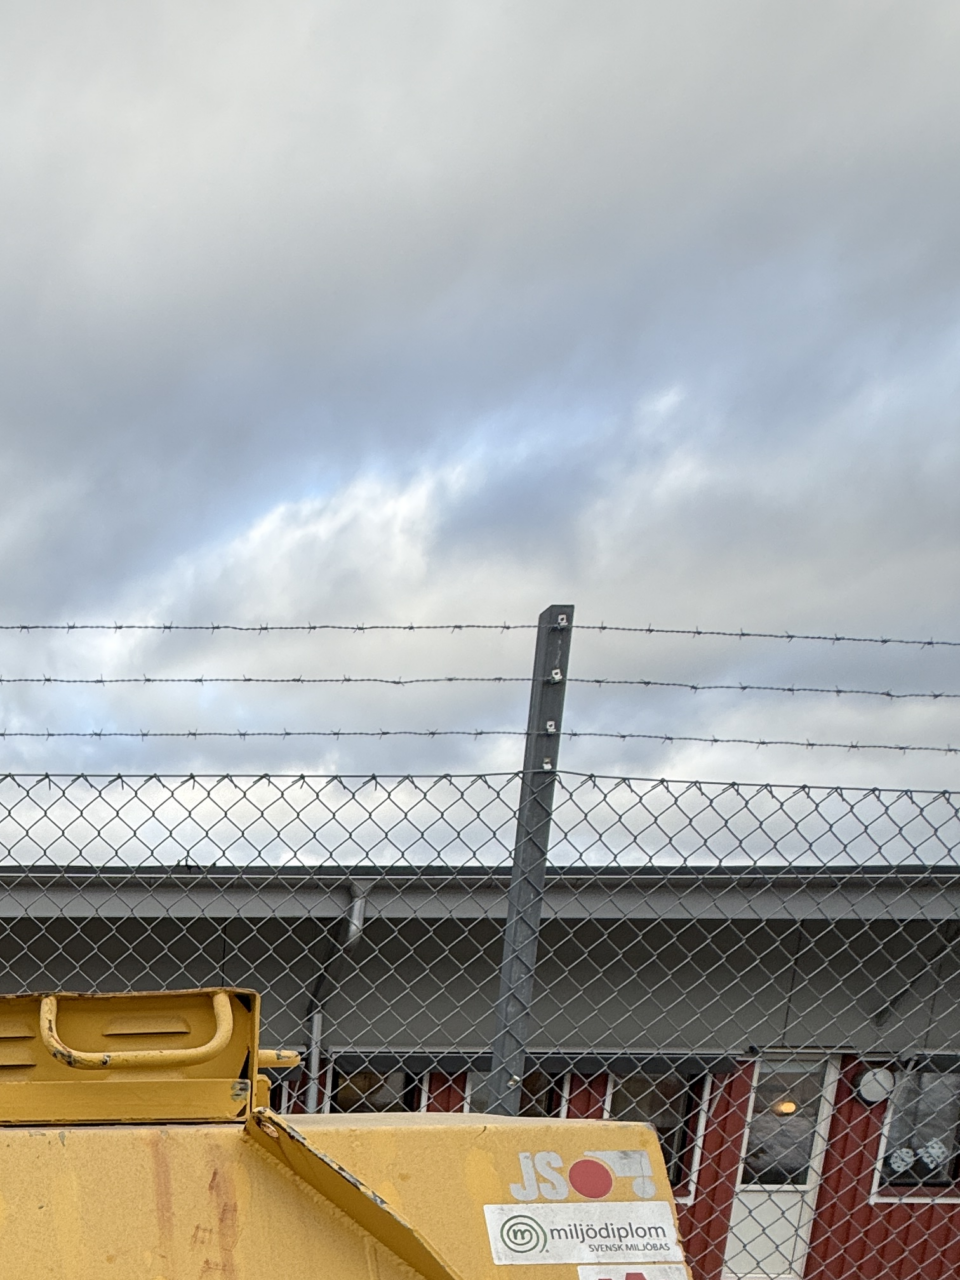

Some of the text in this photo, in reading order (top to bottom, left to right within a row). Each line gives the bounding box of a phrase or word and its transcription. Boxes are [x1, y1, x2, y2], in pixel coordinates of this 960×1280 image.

[550, 1222, 667, 1243] miljödiplom
[589, 1241, 671, 1253] SVENSK MILJÖBAS
